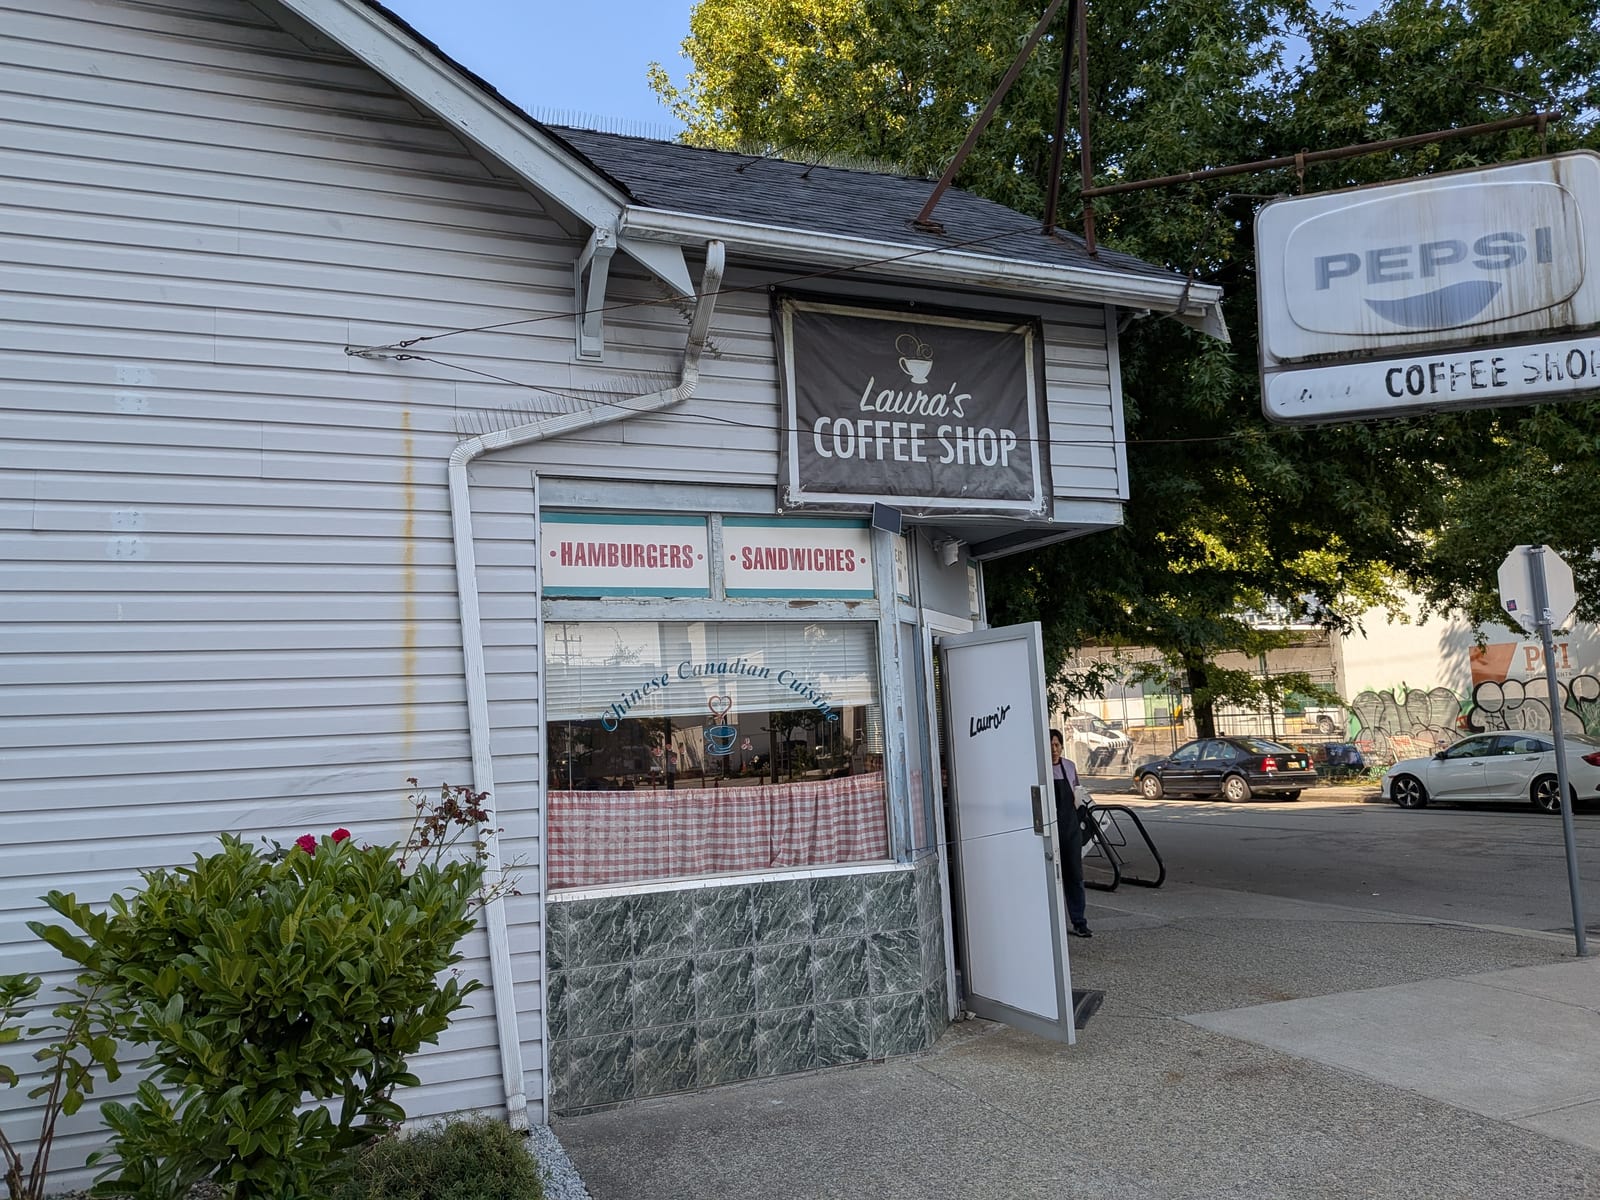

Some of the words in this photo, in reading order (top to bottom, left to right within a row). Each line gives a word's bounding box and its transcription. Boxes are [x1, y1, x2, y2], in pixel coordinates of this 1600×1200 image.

[1313, 226, 1554, 291] PEPSI
[859, 376, 972, 418] Laura's
[1385, 357, 1508, 398] COFFEE
[813, 416, 927, 463] COFFEE
[937, 424, 1017, 467] SHOP
[560, 541, 694, 569] HAMBURGERS
[741, 546, 856, 573] SANDWICHES
[600, 672, 669, 732] Chinese
[677, 657, 771, 680] Canadian
[776, 669, 840, 723] Cuisine
